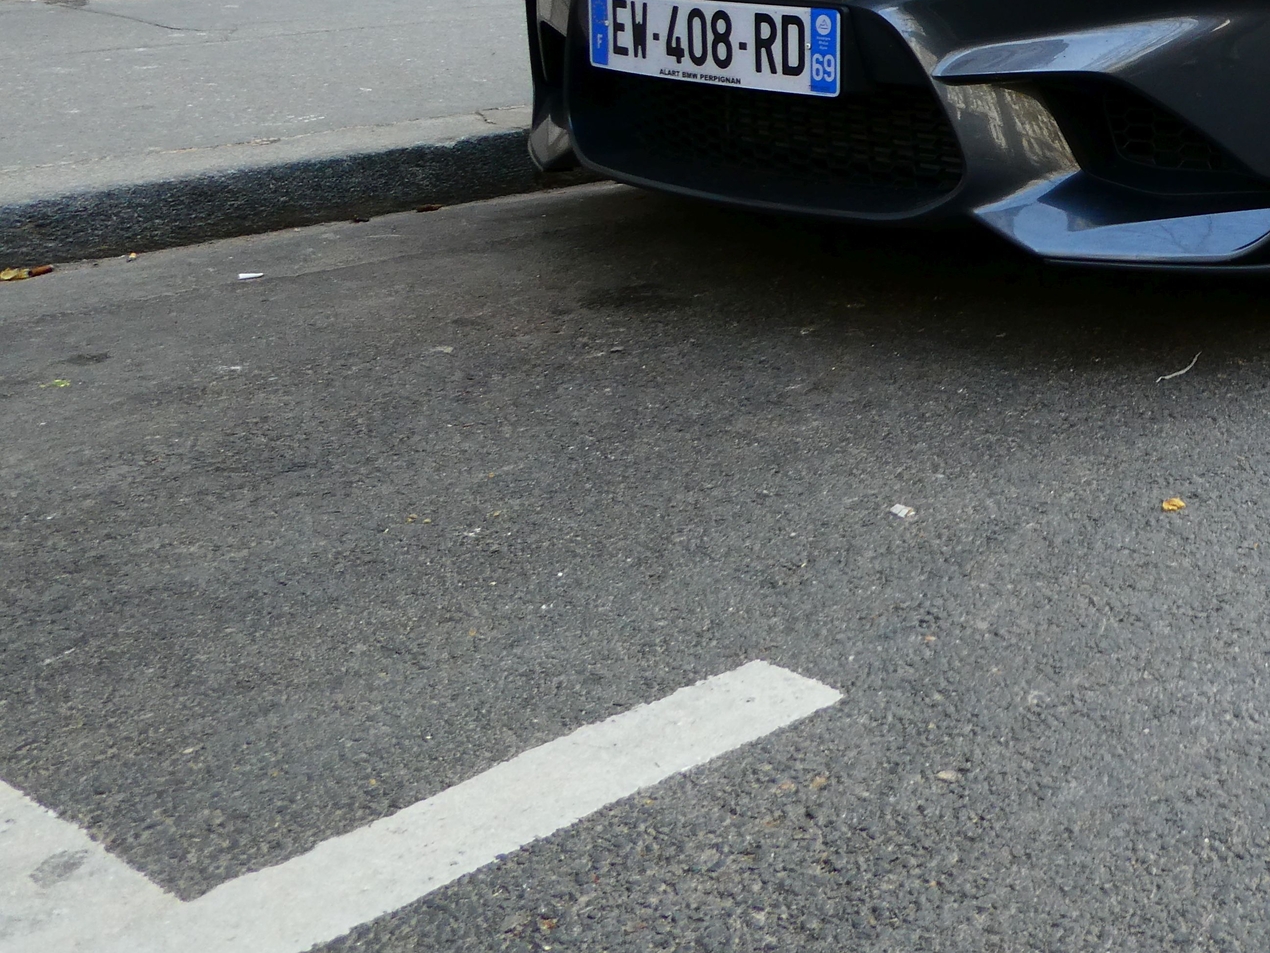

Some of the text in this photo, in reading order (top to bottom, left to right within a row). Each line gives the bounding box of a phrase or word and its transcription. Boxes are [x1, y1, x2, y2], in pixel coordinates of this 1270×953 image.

[659, 68, 741, 84] ALART BMW PERPIGNAN
[812, 53, 836, 82] 69
